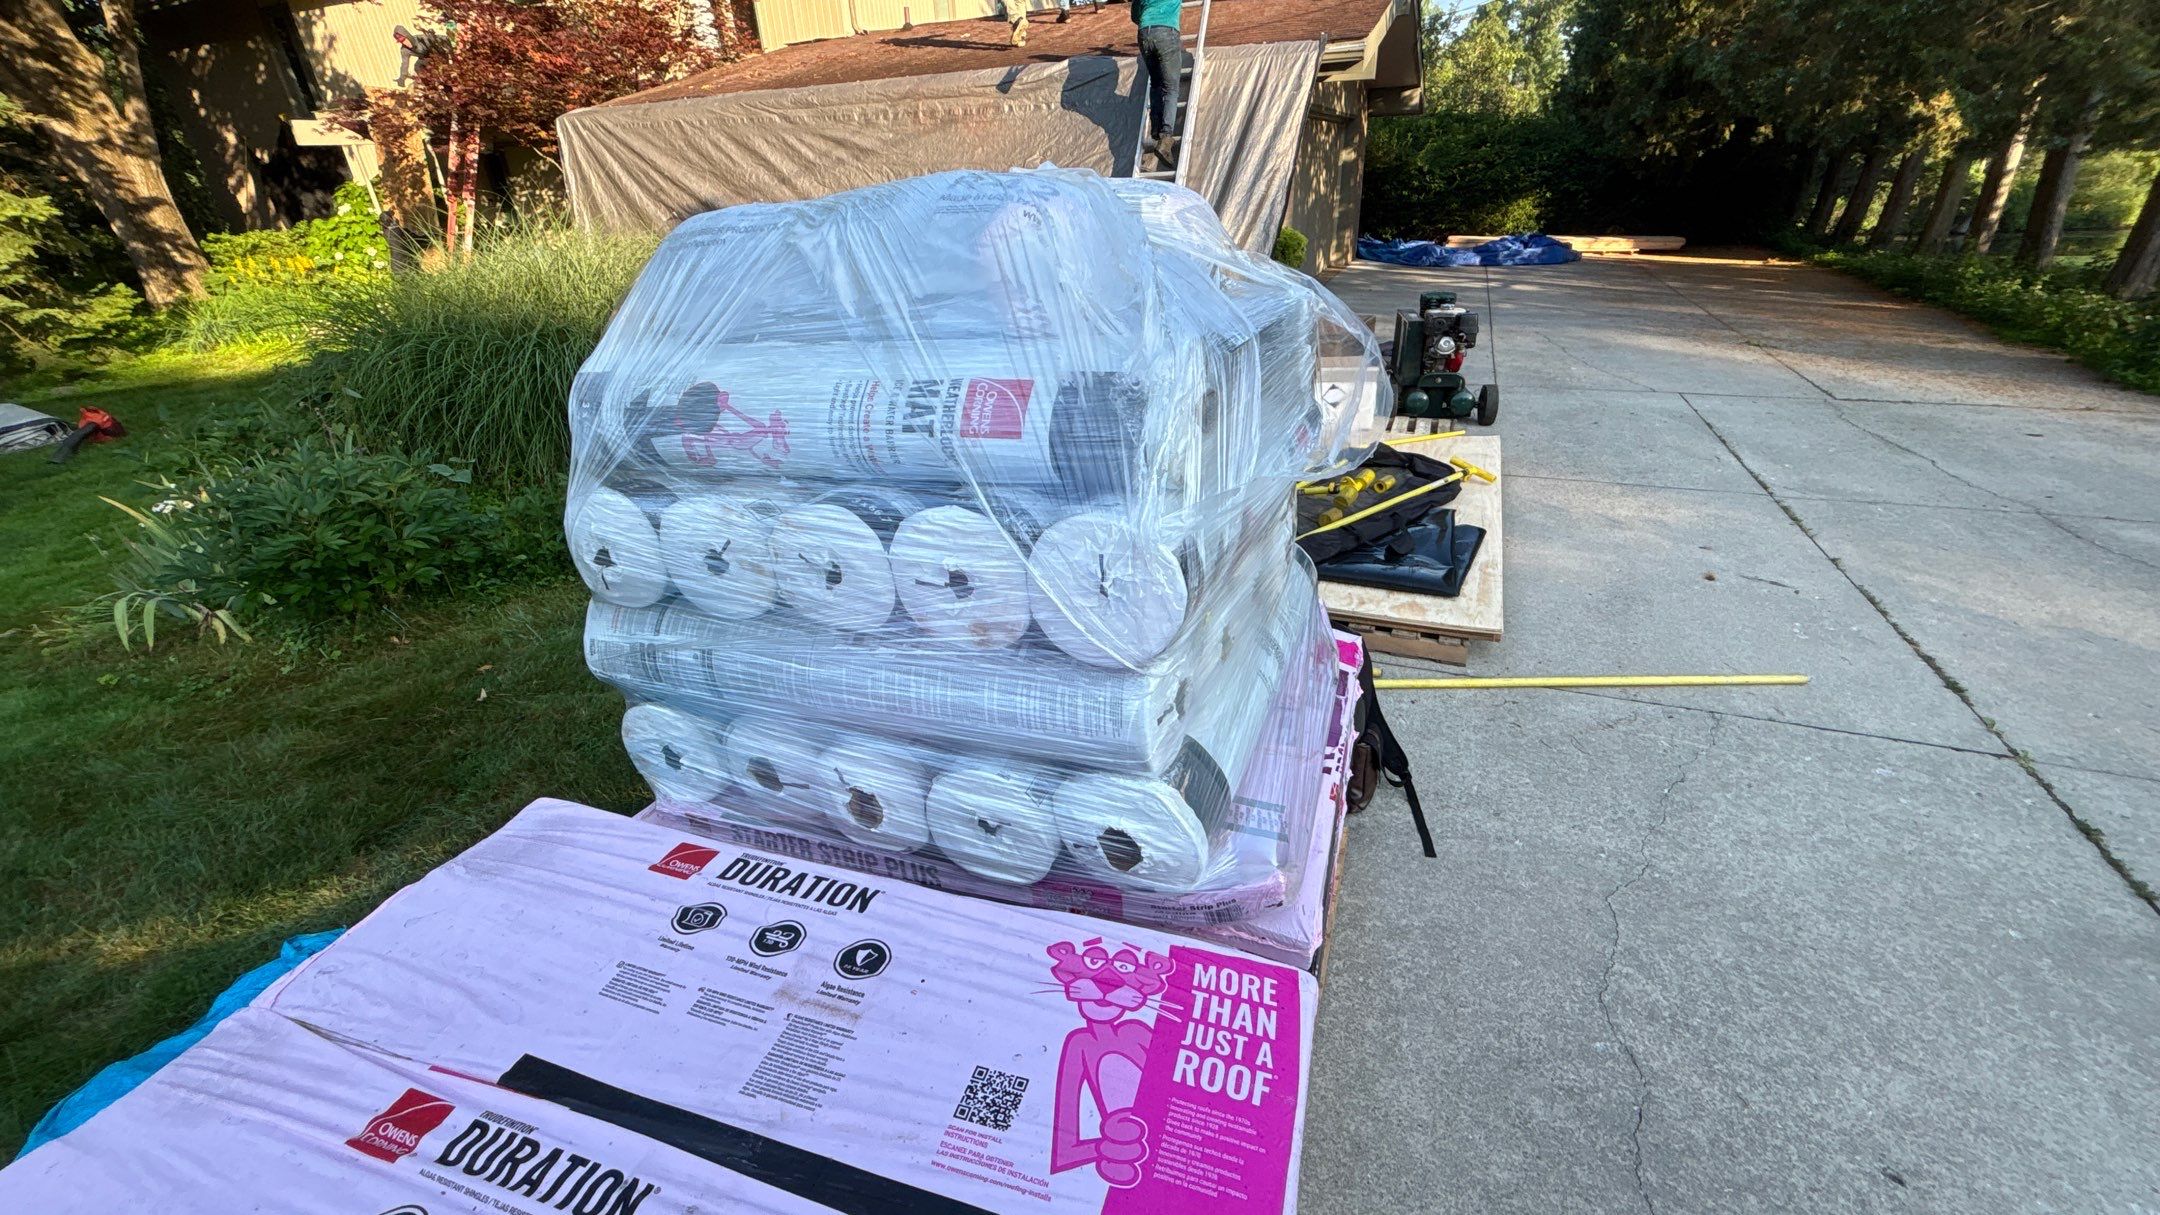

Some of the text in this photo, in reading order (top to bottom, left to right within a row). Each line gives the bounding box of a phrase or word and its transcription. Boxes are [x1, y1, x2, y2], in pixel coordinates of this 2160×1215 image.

[866, 380, 880, 402] Helps
[863, 404, 874, 433] Create
[902, 379, 944, 438] MAT
[969, 382, 988, 435] CORNING
[980, 390, 997, 434] OWENS
[670, 860, 701, 871] OWENS
[730, 824, 810, 860] STARTER
[817, 840, 880, 870] STRIP
[885, 856, 942, 888] PLUS
[716, 858, 880, 913] DURATION
[1216, 898, 1236, 908] Plus
[730, 964, 772, 980] Limited Warranty
[749, 960, 761, 970] Wind
[761, 963, 788, 977] Resistance
[816, 989, 861, 1006] Limited Warranty
[821, 981, 865, 998] Algae Resistance
[1193, 962, 1278, 1007] MORE
[1191, 989, 1277, 1040] THAN
[1181, 1021, 1273, 1069] JUST A
[1172, 1048, 1272, 1107] ROOF
[379, 1122, 418, 1147] OWENS
[481, 1110, 538, 1134] TRUDEFINITION
[947, 1124, 1002, 1144] SCAN FOR INSTALL
[940, 1140, 1014, 1168] ESCANEE PARA OBTENER
[944, 1130, 988, 1149] INSTRUCTIONS
[434, 1119, 654, 1215] DURATION
[936, 1149, 1050, 1188] LAS INSTRUCCIONES DE INSTALACIÓN
[419, 1168, 436, 1181] ALGAE
[436, 1176, 465, 1192] RESISTANT
[463, 1186, 490, 1203] SHINGLES
[492, 1199, 510, 1212] TEJAS
